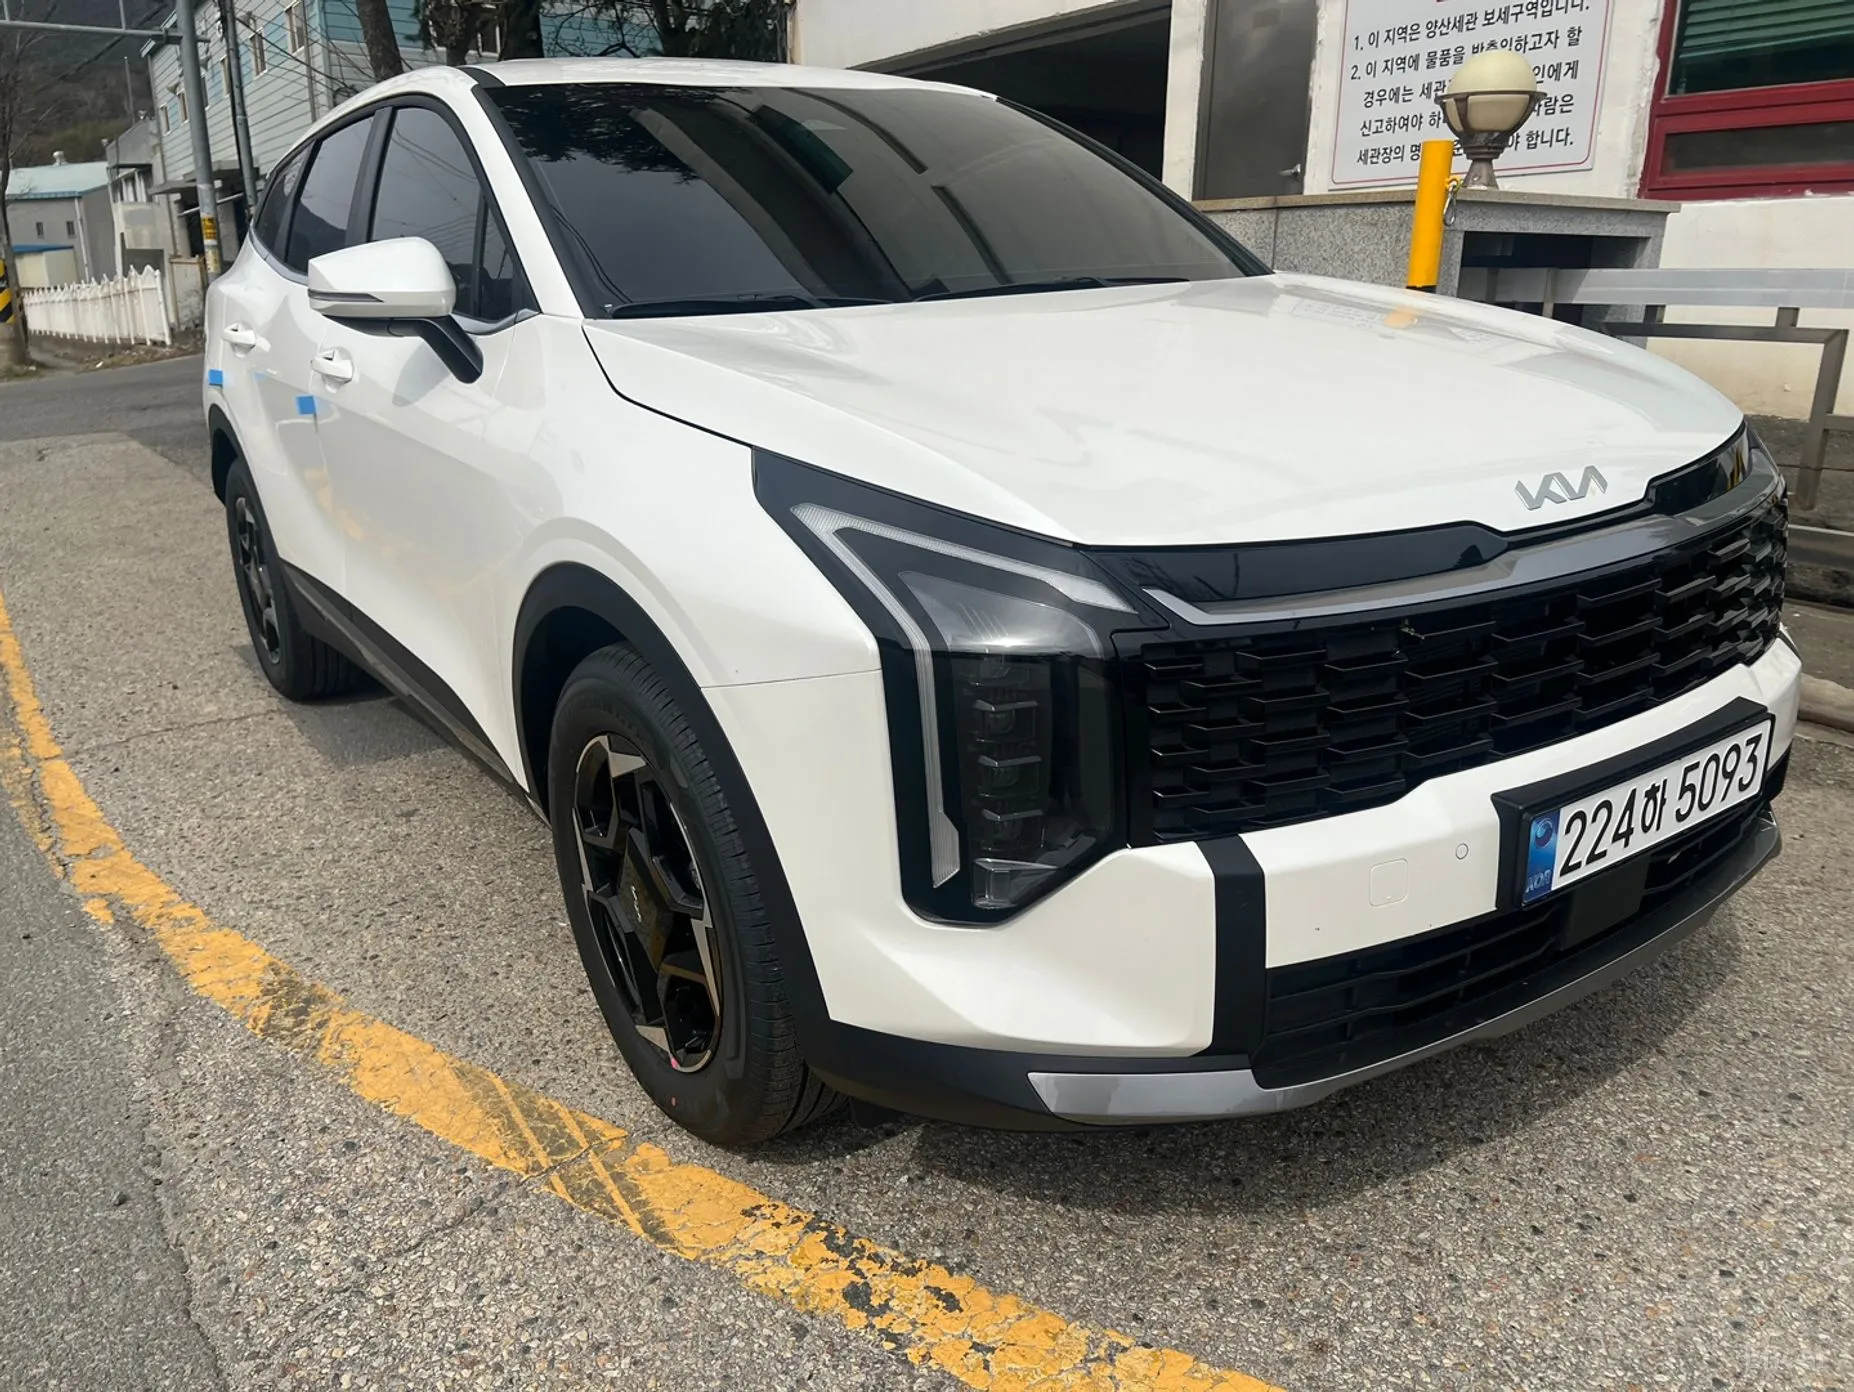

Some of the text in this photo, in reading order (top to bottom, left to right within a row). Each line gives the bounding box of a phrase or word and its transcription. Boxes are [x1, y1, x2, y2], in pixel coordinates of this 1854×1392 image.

[1354, 35, 1364, 51] 1.
[1368, 30, 1380, 48] 이
[1384, 23, 1421, 45] 지역은
[1425, 11, 1478, 39] 양산세관
[1350, 64, 1361, 80] 2.
[1365, 60, 1377, 78] 이
[1382, 53, 1420, 75] 지역에
[1425, 45, 1466, 70] 물품을
[1567, 26, 1582, 47] 할
[1364, 85, 1414, 109] 경우에는
[1360, 113, 1424, 137] 신고하여야
[1357, 145, 1405, 165] 세관장의
[1526, 127, 1574, 150] 합니다.
[1515, 464, 1608, 511] KIA
[1560, 734, 1762, 877] 224하 5093
